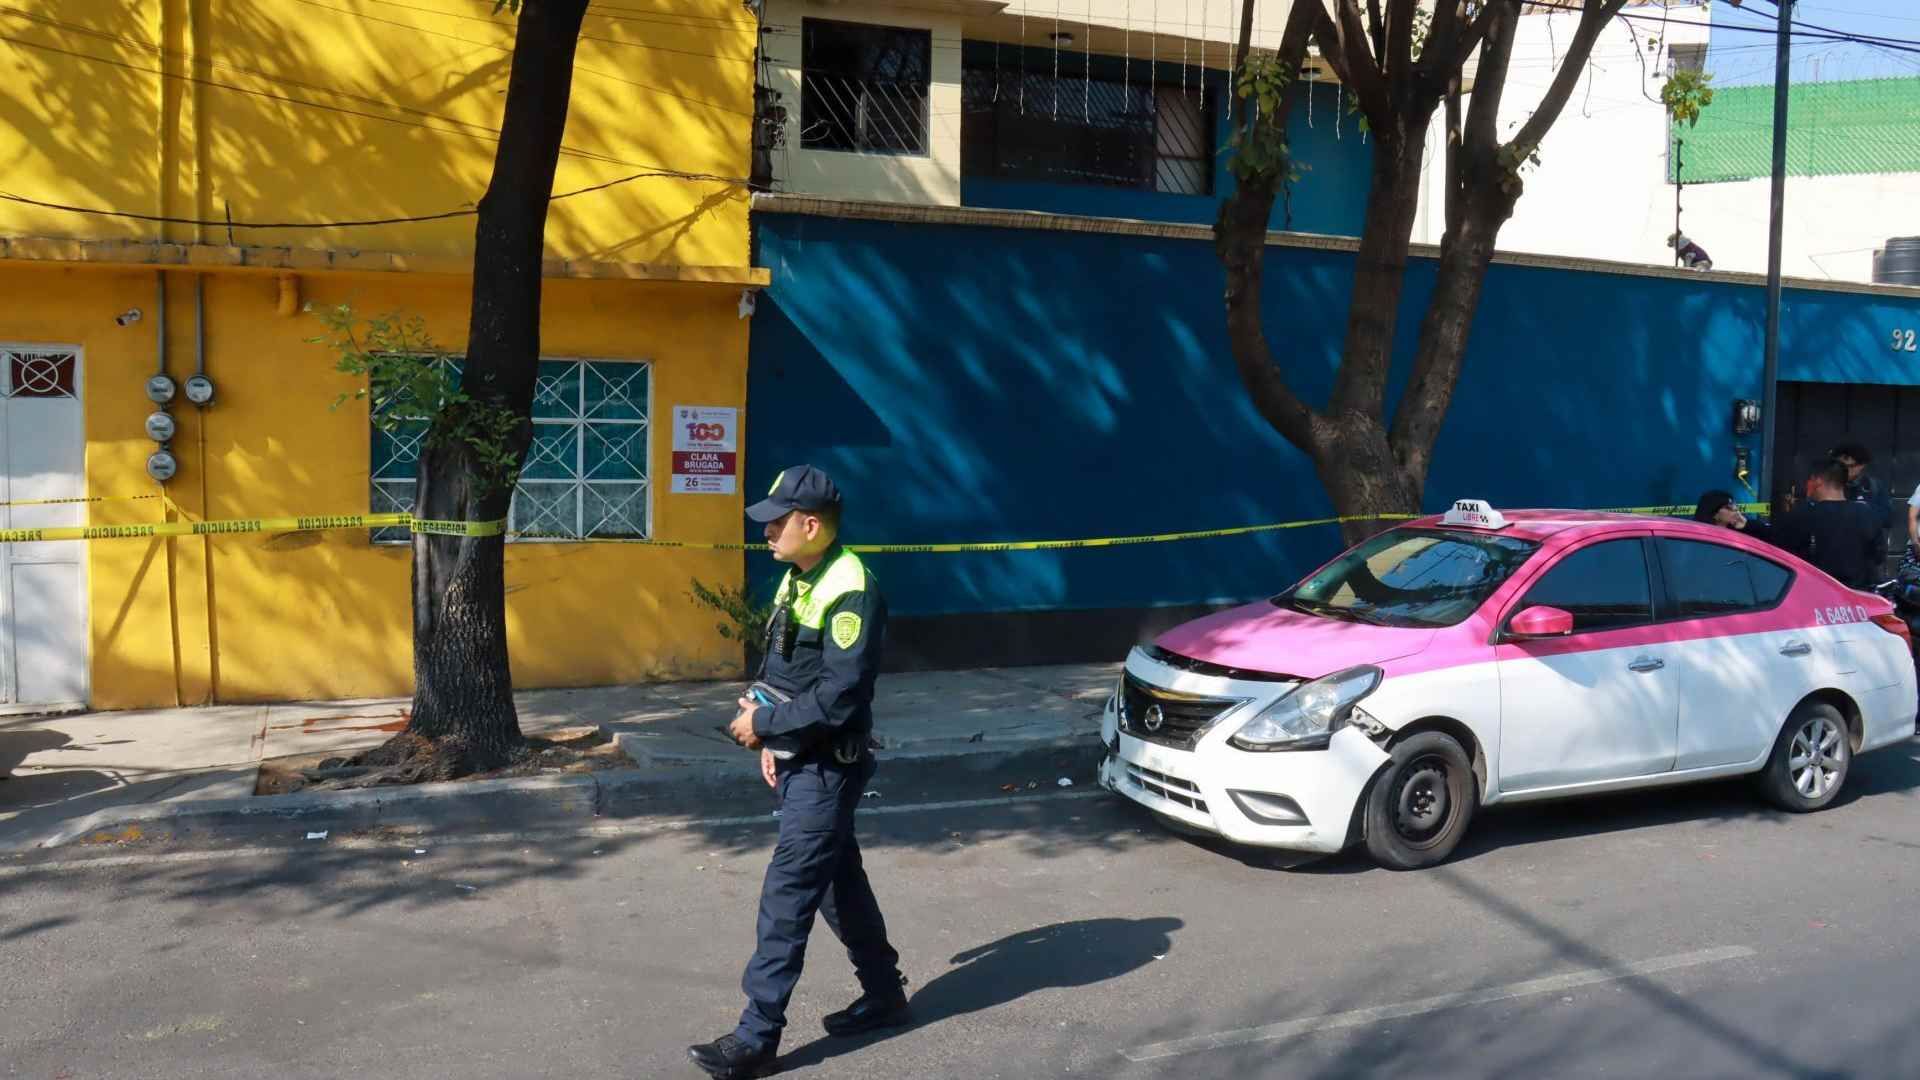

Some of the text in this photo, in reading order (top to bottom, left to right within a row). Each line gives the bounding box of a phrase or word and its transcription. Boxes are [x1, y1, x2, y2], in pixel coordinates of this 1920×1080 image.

[1892, 328, 1917, 351] 92
[686, 422, 725, 441] 100
[690, 453, 719, 461] CLARA
[684, 461, 724, 470] BRUGADA
[685, 477, 698, 487] 26
[1456, 502, 1479, 512] TAXI
[1814, 607, 1827, 625] A
